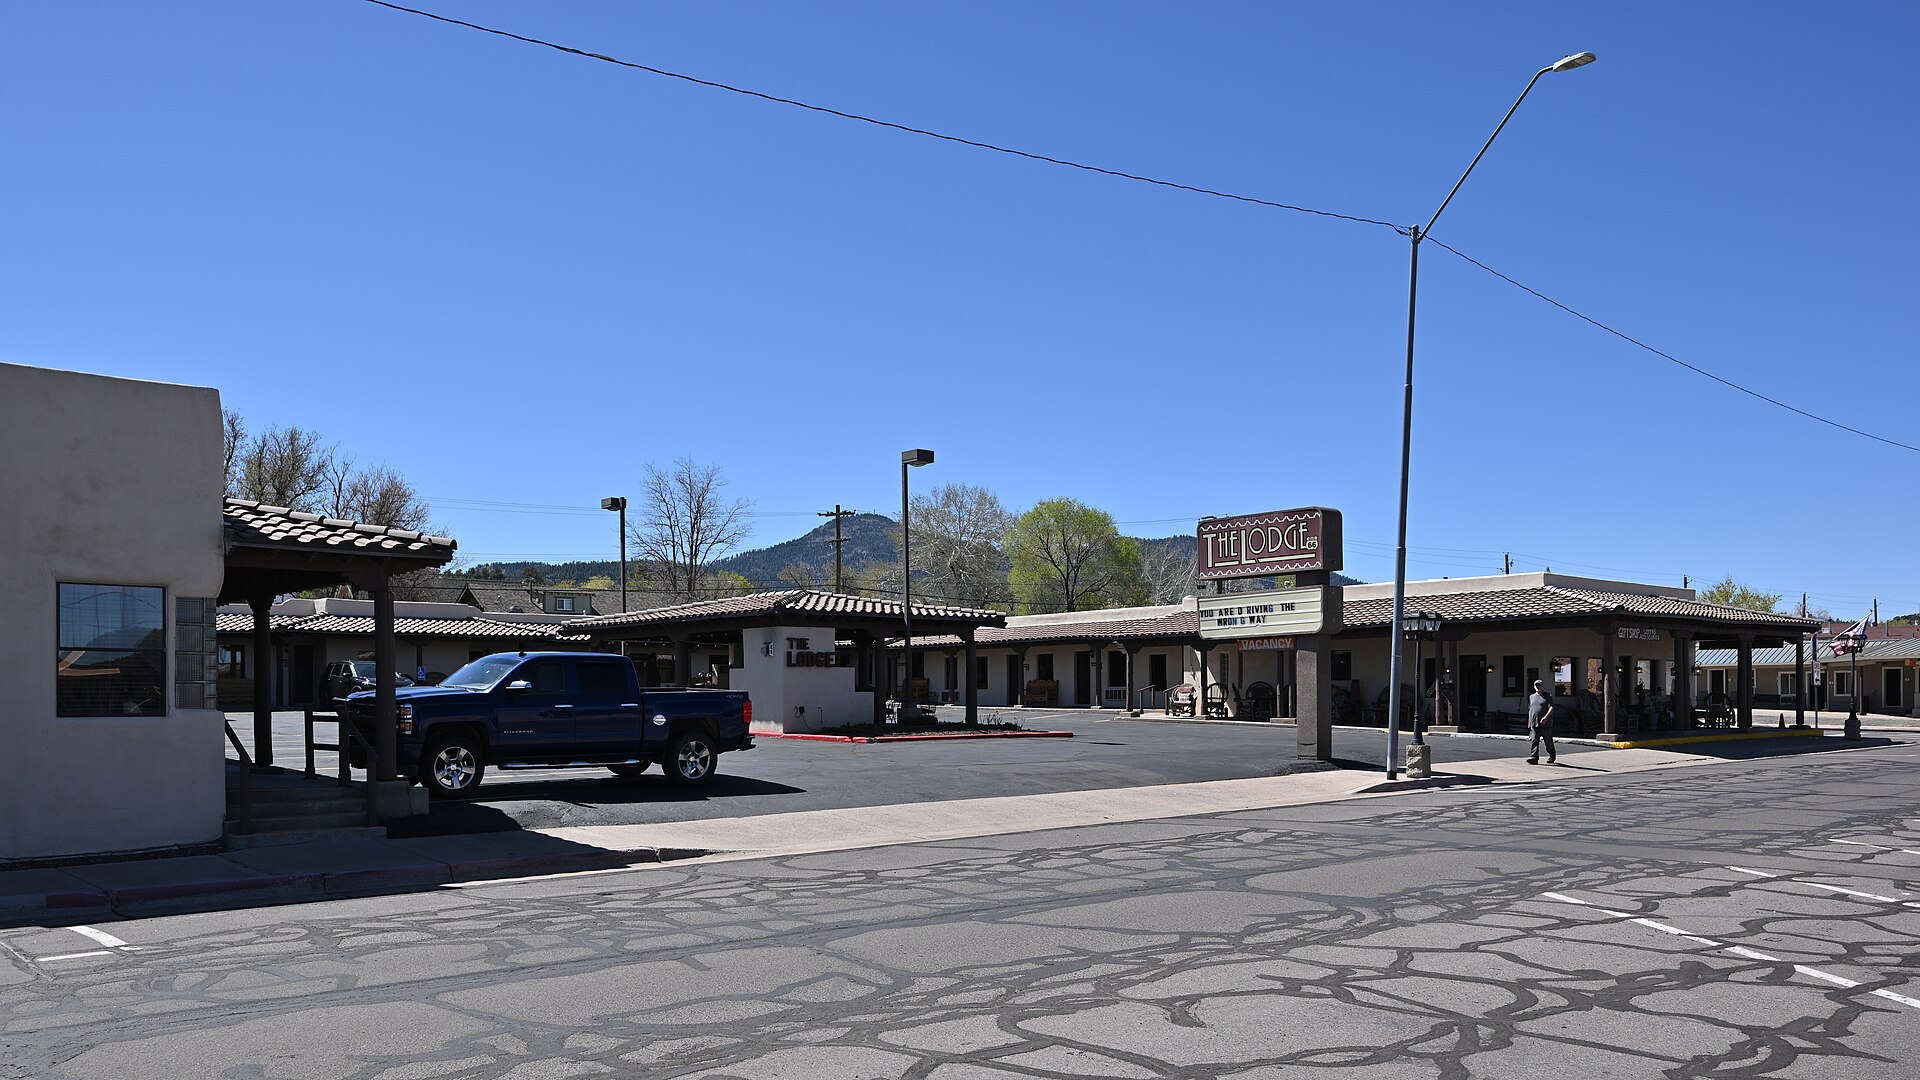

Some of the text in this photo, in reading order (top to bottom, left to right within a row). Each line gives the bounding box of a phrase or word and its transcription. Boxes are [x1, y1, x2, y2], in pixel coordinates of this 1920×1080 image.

[1202, 531, 1239, 568] THE
[1240, 522, 1308, 564] LODGE
[1199, 609, 1214, 618] YOU
[1218, 607, 1234, 617] ARE
[1280, 602, 1296, 611] THE
[1248, 614, 1266, 624] WAY
[786, 637, 810, 649] THE
[1241, 638, 1293, 650] VACANCY
[786, 651, 838, 667] LODGE
